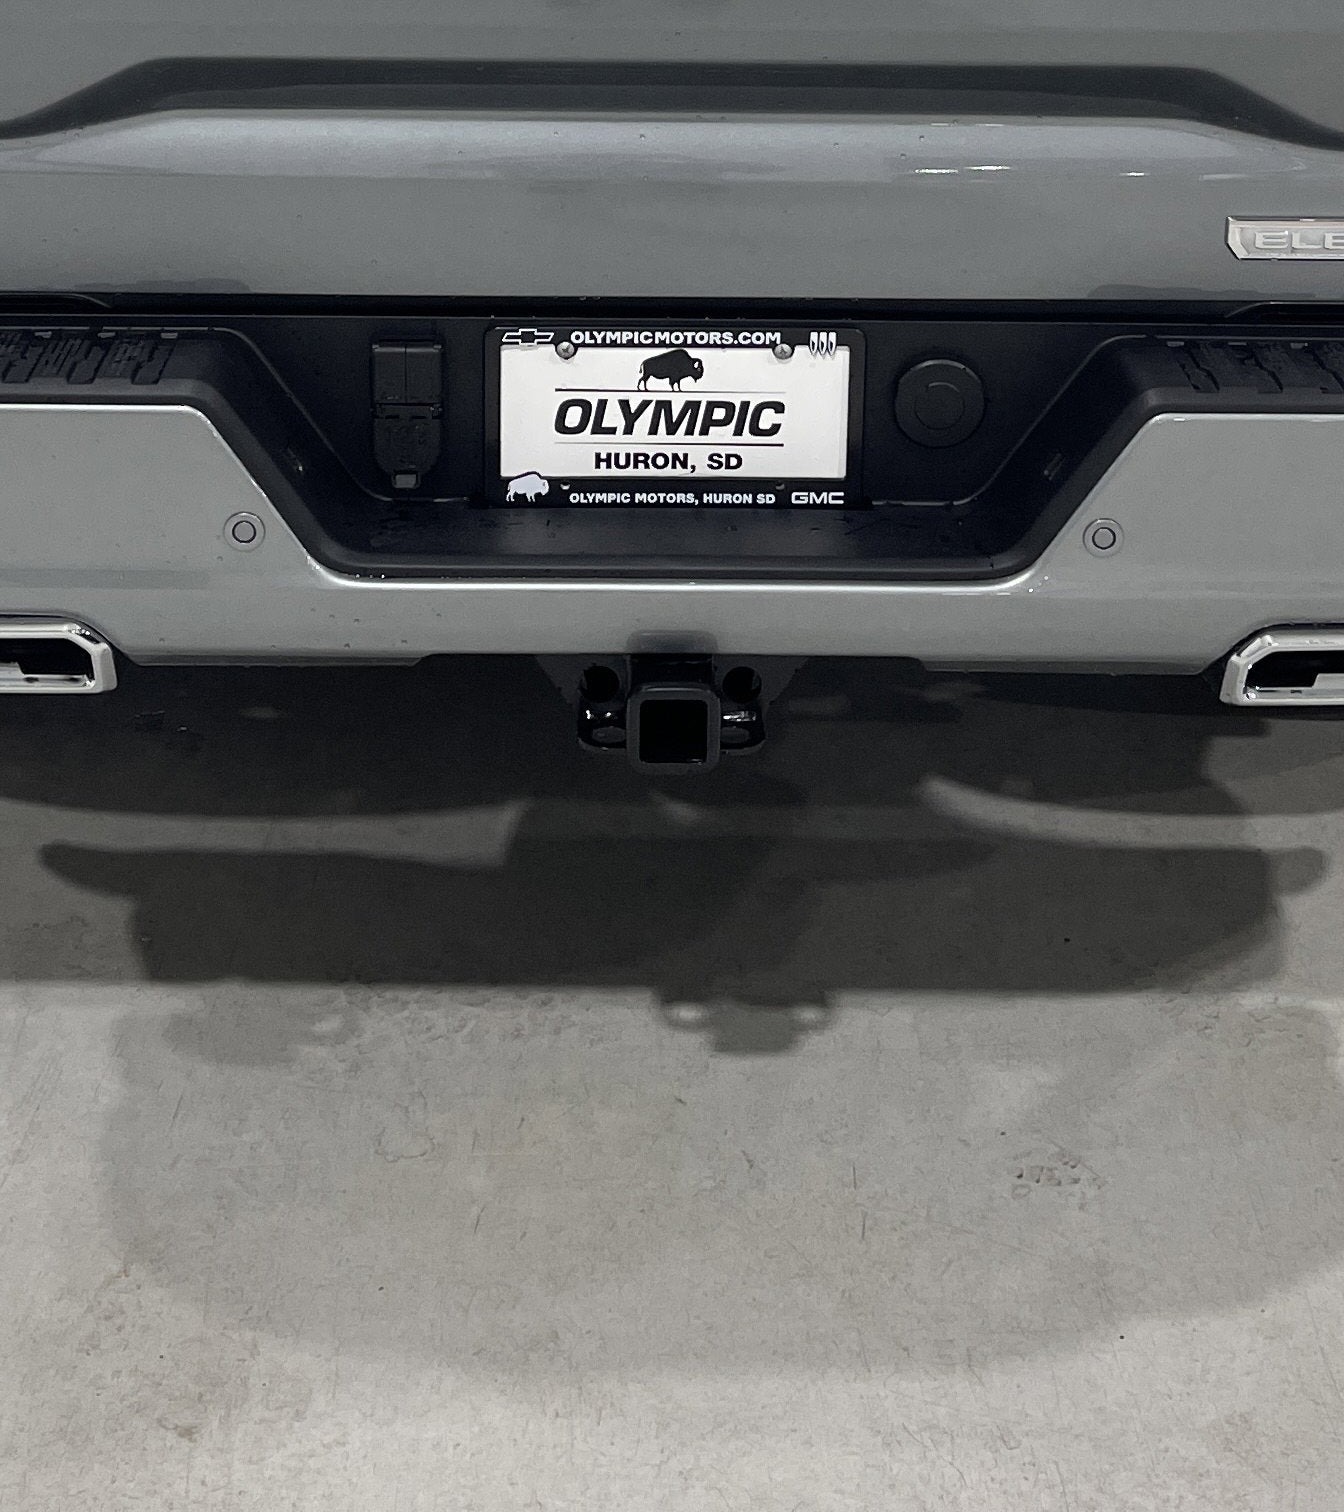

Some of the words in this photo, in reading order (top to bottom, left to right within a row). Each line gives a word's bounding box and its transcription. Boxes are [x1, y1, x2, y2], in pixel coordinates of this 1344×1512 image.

[570, 331, 781, 345] OLYMPICMOTORS.COM
[554, 398, 786, 437] OLYMPIC
[594, 452, 696, 473] HURON,
[707, 453, 743, 470] SD
[569, 492, 631, 504] OLYMPIC
[635, 492, 699, 506] MOTORS,
[703, 493, 753, 505] HURON
[756, 493, 776, 505] SD
[791, 492, 845, 505] GMC
